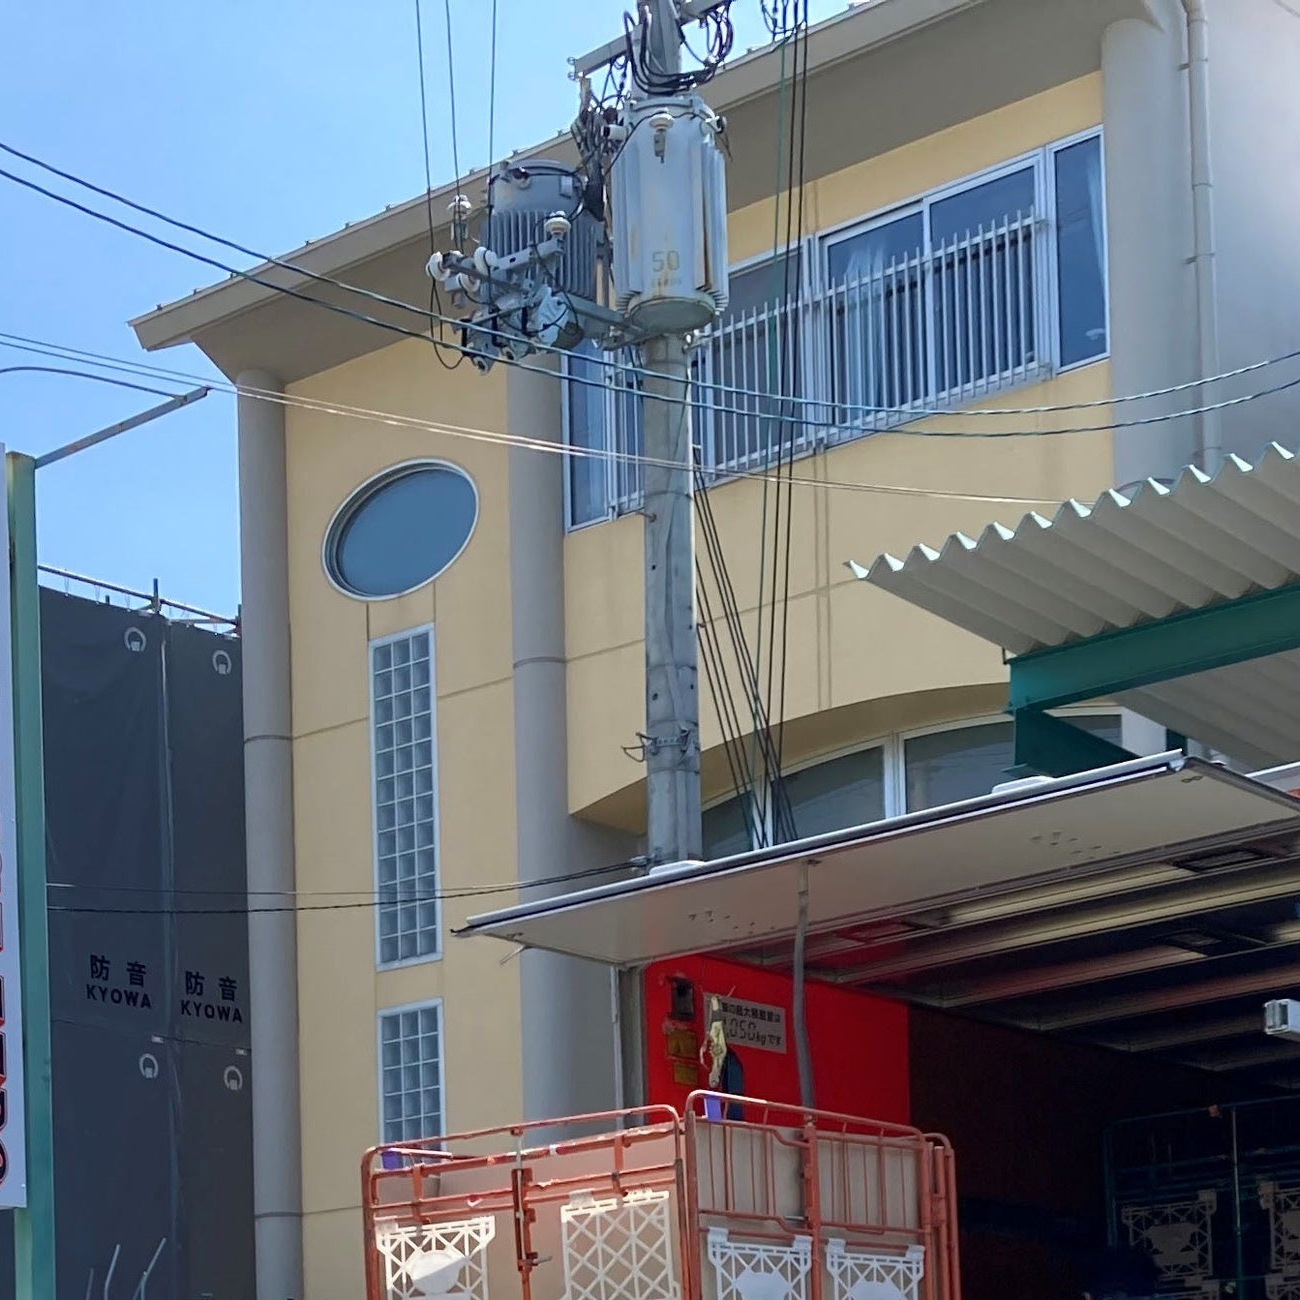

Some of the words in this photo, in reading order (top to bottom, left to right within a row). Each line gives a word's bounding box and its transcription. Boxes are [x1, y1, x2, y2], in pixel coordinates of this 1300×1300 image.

[652, 250, 680, 272] 50
[90, 954, 147, 988] 防音
[86, 984, 152, 1009] KYOWA
[185, 971, 238, 1002] 防音
[181, 1000, 243, 1023] KYOWA
